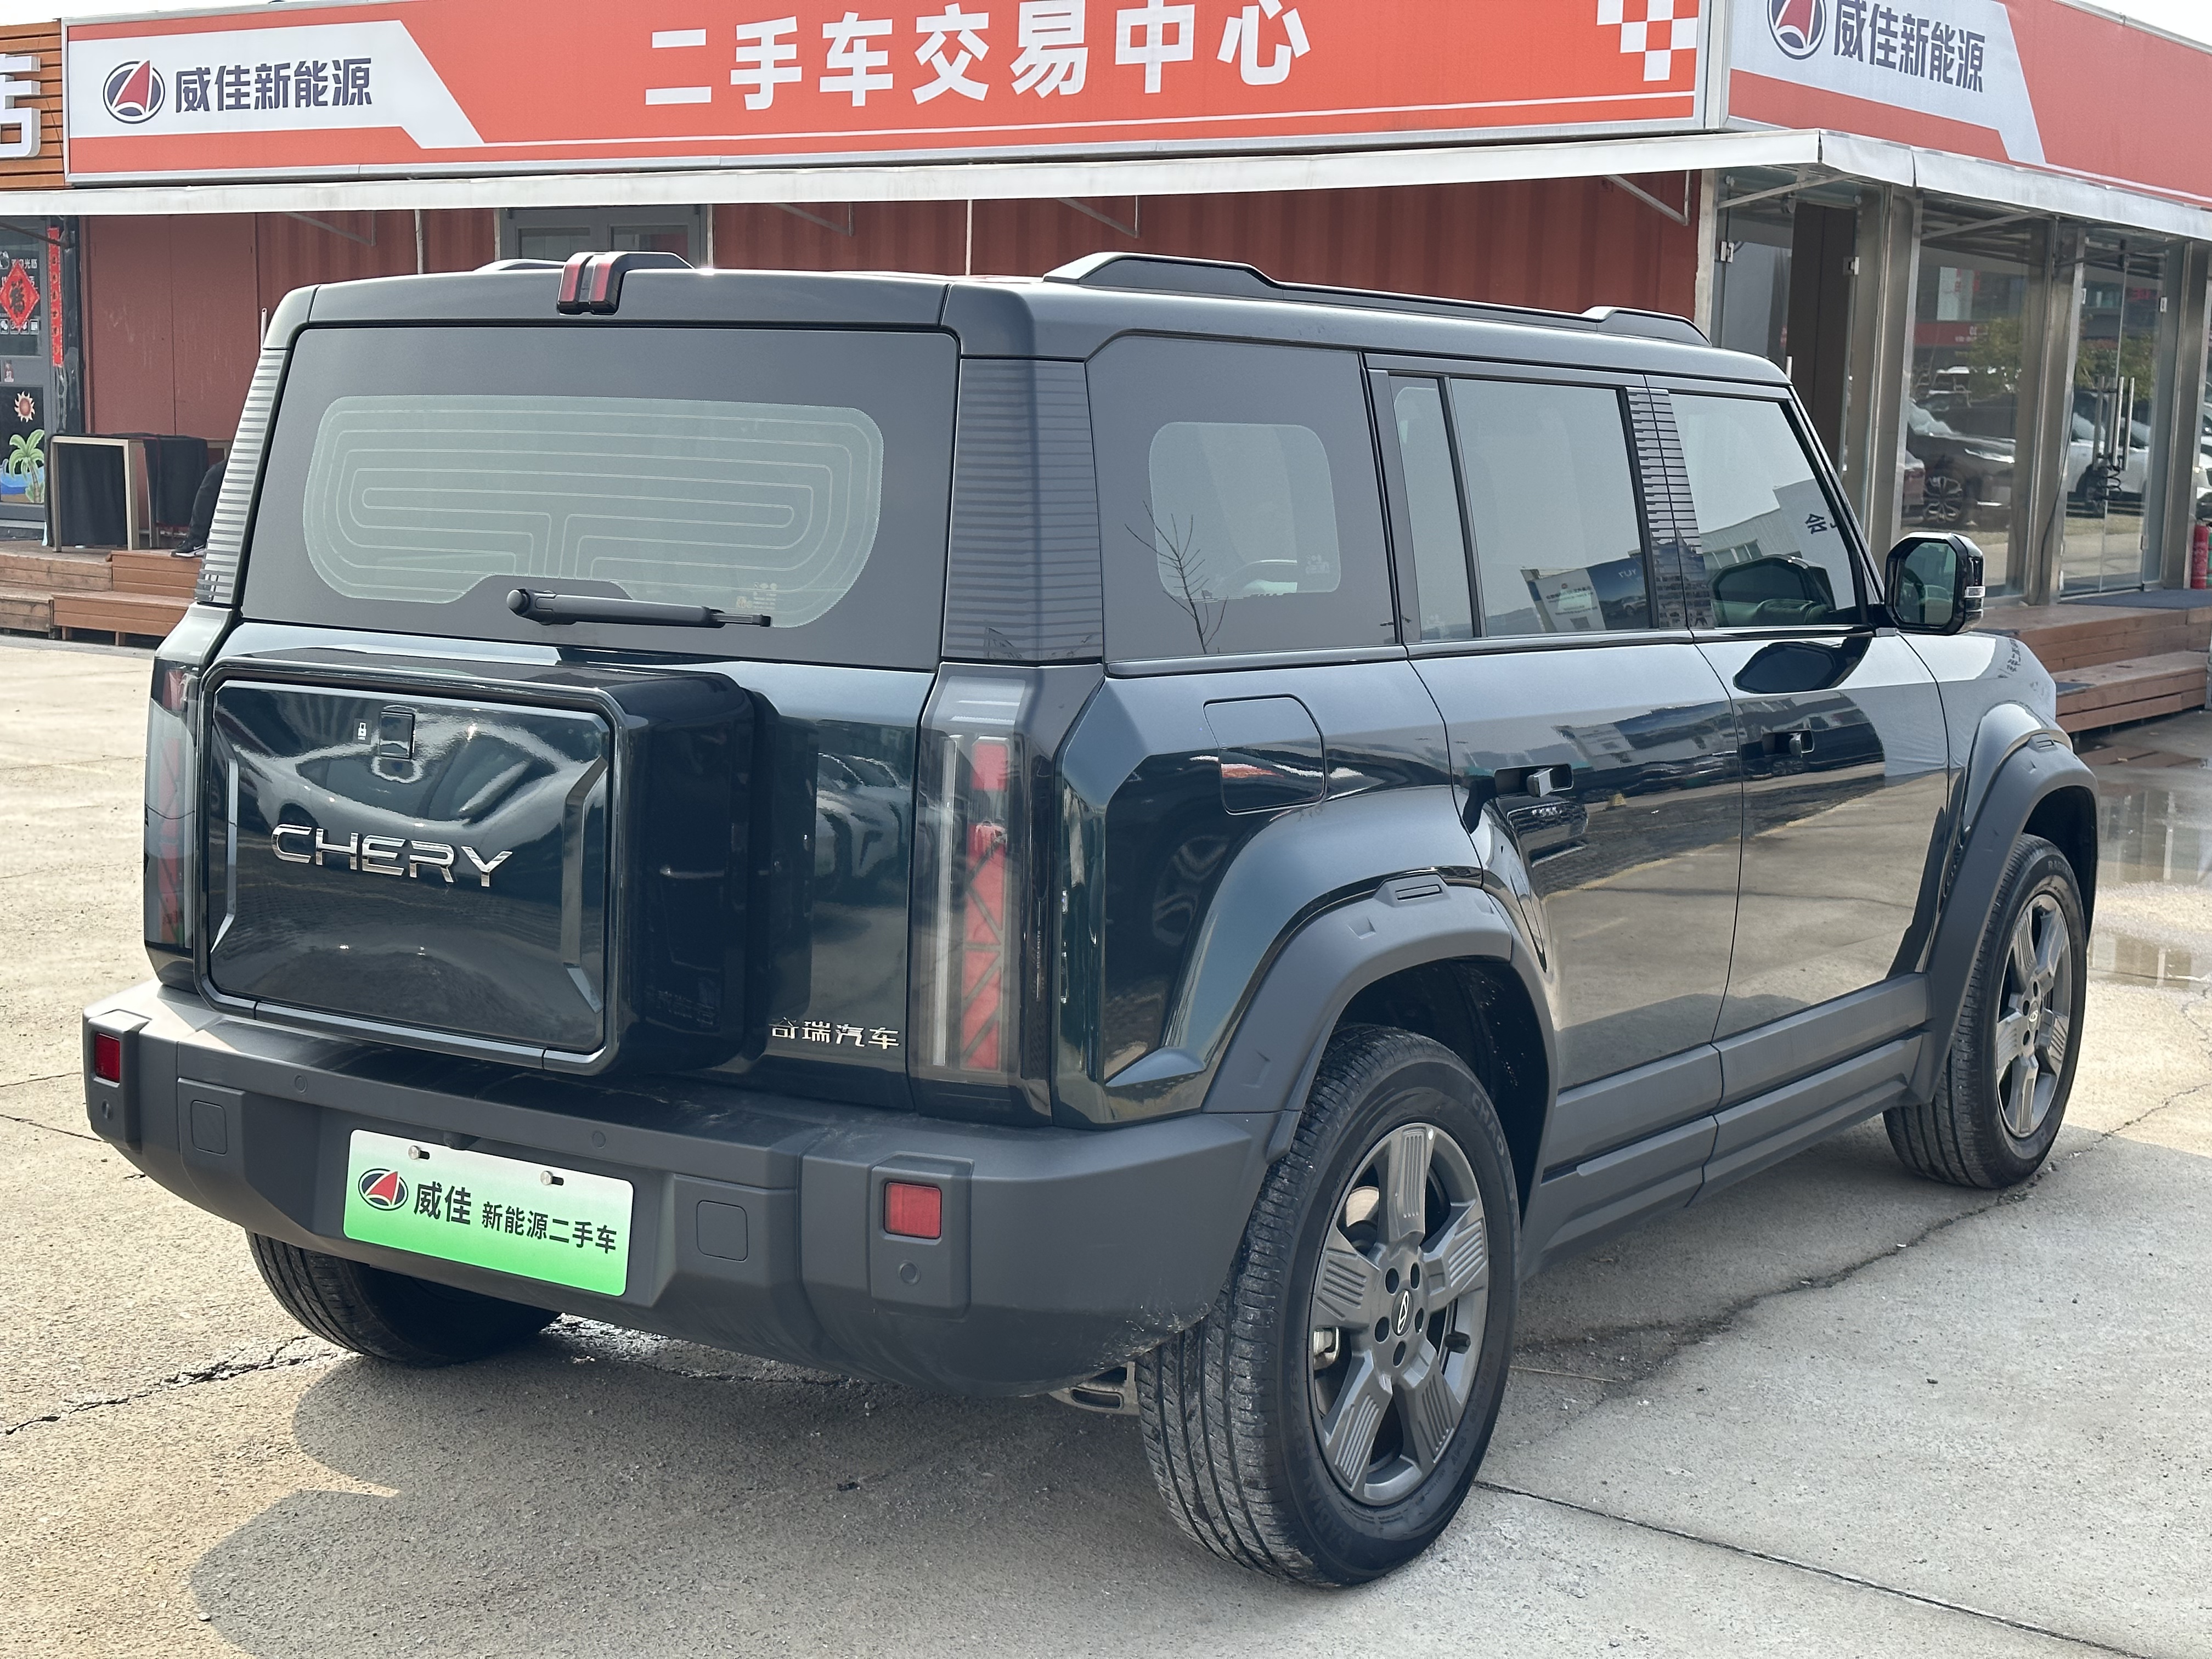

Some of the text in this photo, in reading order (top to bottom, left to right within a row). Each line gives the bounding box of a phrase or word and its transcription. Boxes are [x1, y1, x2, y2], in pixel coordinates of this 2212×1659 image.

[645, 0, 1312, 110] 二手车交易中心
[1833, 0, 1986, 93] 威佳新能源
[175, 57, 373, 113] 威佳新能源
[271, 823, 513, 887] CHERY
[768, 1017, 900, 1049] 奇瑞汽车
[413, 1181, 617, 1254] 威佳 新能源二手车
